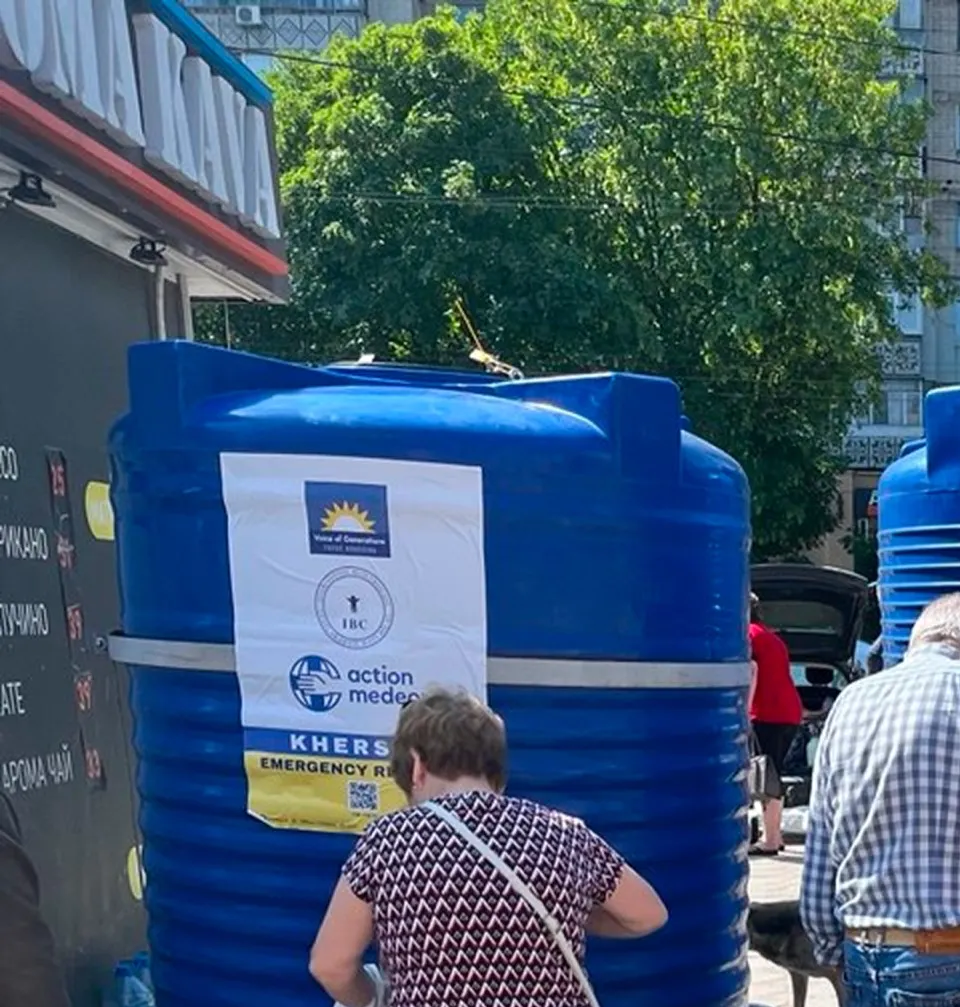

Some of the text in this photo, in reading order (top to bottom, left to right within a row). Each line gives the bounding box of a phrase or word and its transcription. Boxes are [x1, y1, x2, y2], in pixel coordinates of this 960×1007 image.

[342, 618, 366, 630] IBC
[348, 665, 414, 686] action
[0, 681, 26, 716] АТЕ
[349, 686, 421, 705] medeo
[290, 733, 390, 757] KHERS
[2, 743, 74, 793] АРОМА ЧАЙ
[260, 757, 368, 777] EMERGENCY
